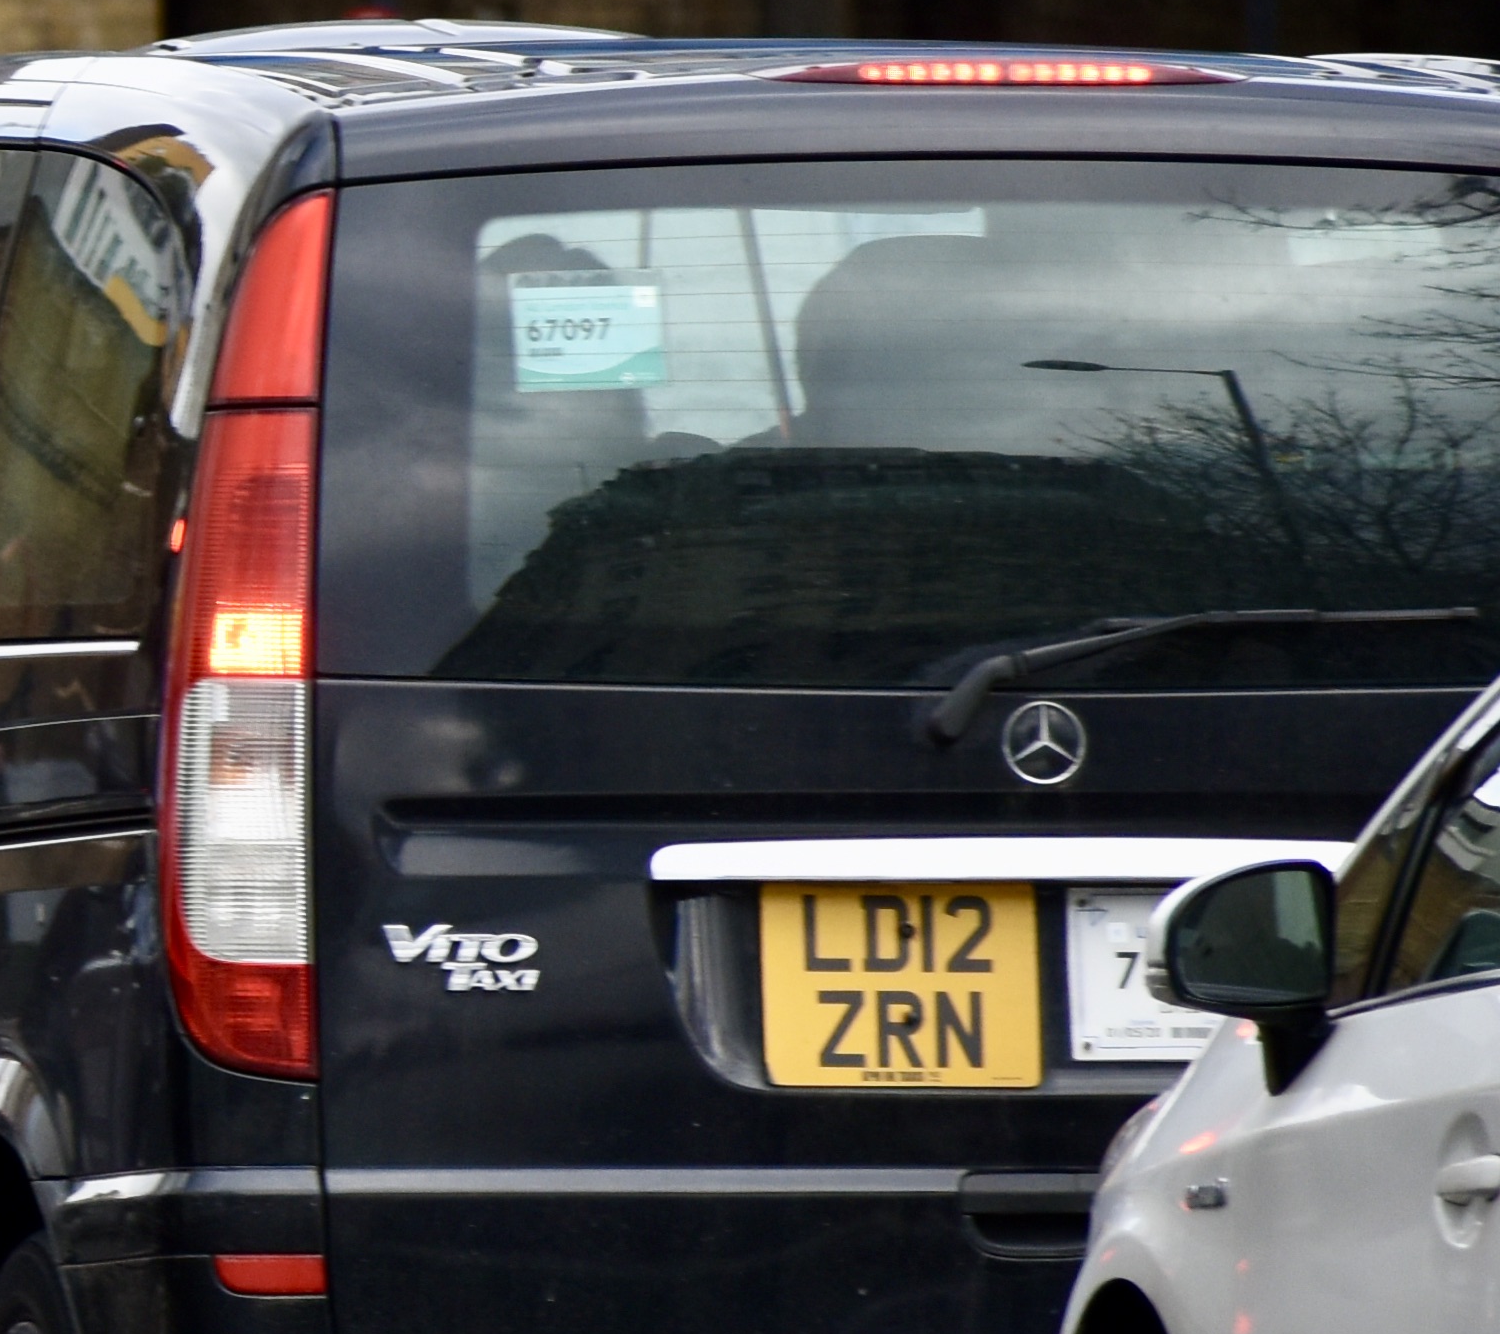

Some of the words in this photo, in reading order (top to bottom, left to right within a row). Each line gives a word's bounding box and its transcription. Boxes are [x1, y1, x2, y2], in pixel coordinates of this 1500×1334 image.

[527, 318, 612, 342] 67097
[802, 895, 994, 973] LD12
[817, 990, 984, 1068] ZRN
